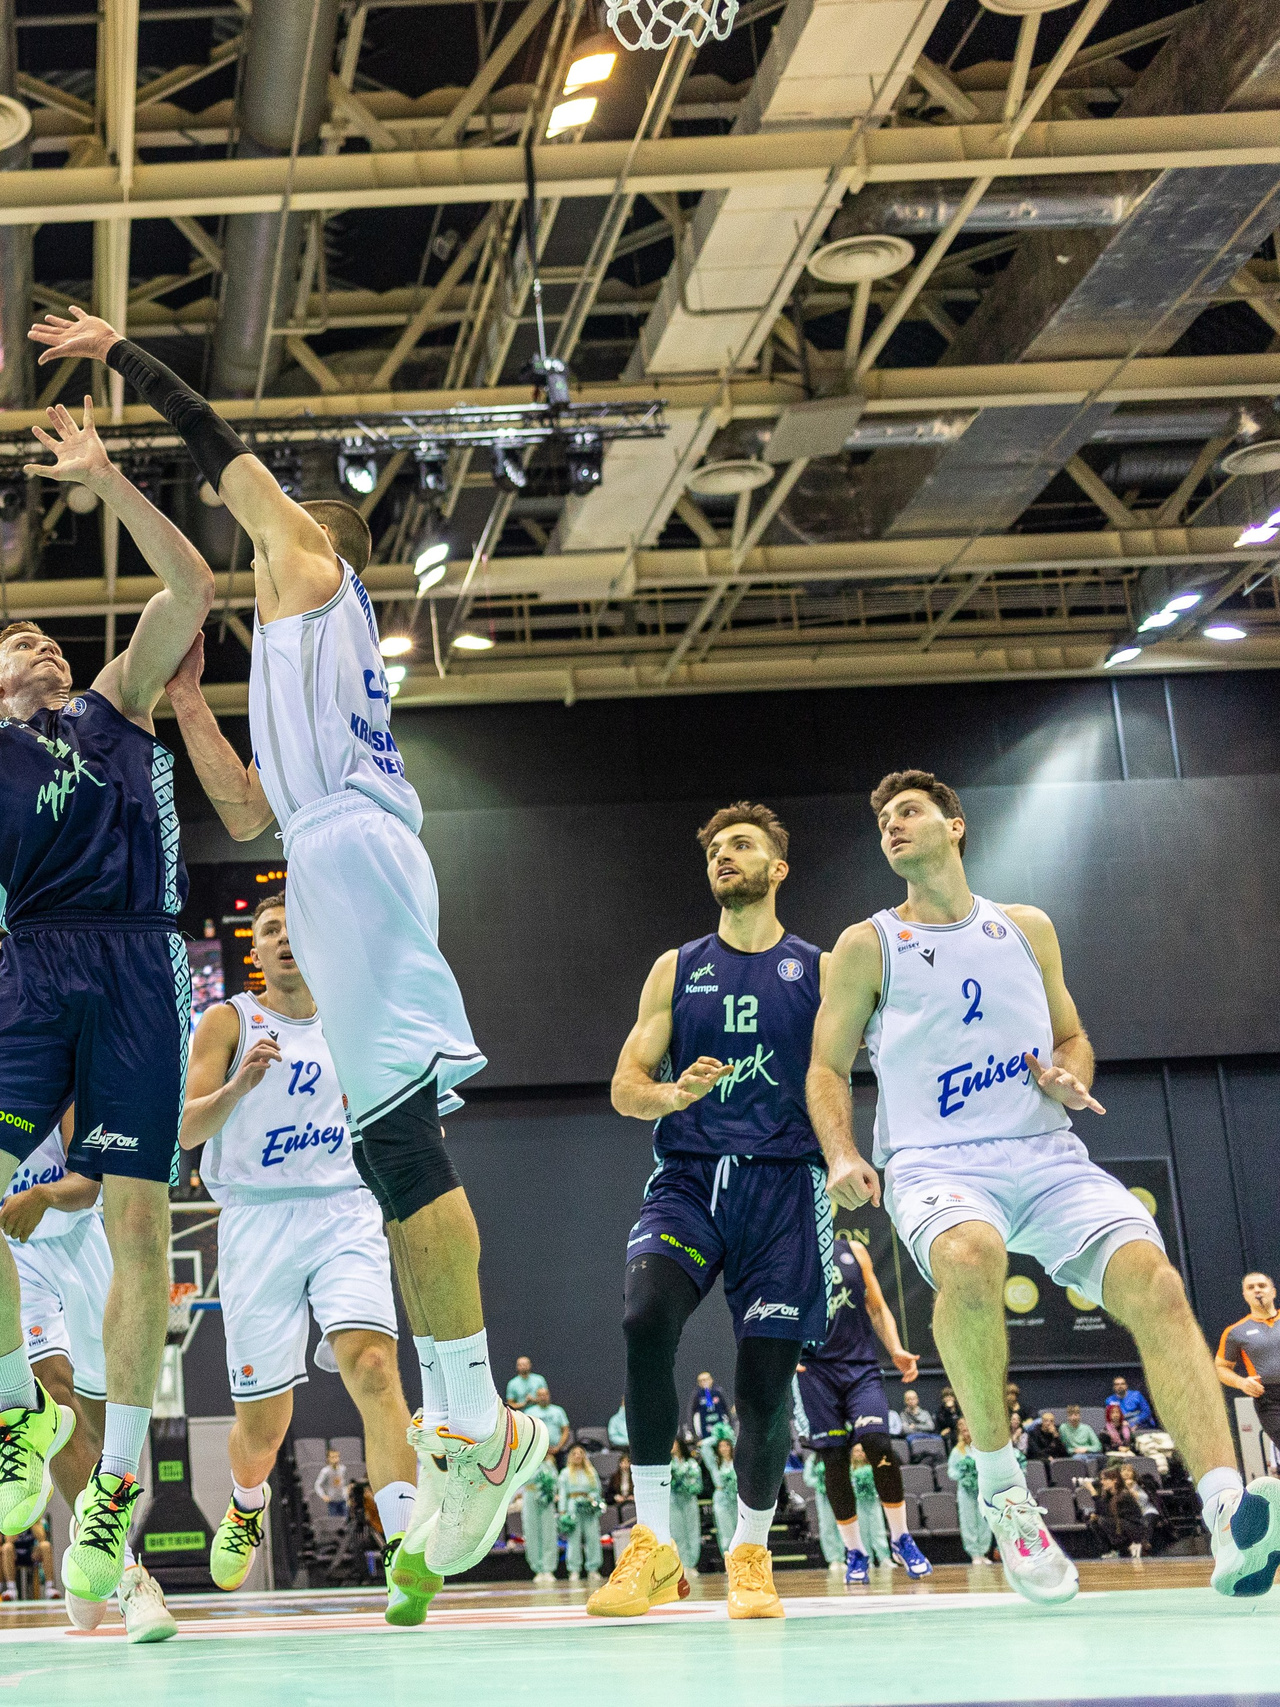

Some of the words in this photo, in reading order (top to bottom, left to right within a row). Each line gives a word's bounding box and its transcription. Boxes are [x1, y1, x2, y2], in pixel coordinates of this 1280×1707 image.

[685, 984, 719, 994] Kempa
[961, 978, 983, 1025] 2
[723, 994, 758, 1032] 12
[287, 1060, 322, 1096] 12
[937, 1047, 1040, 1118] Enisey
[261, 1122, 345, 1168] Enisey
